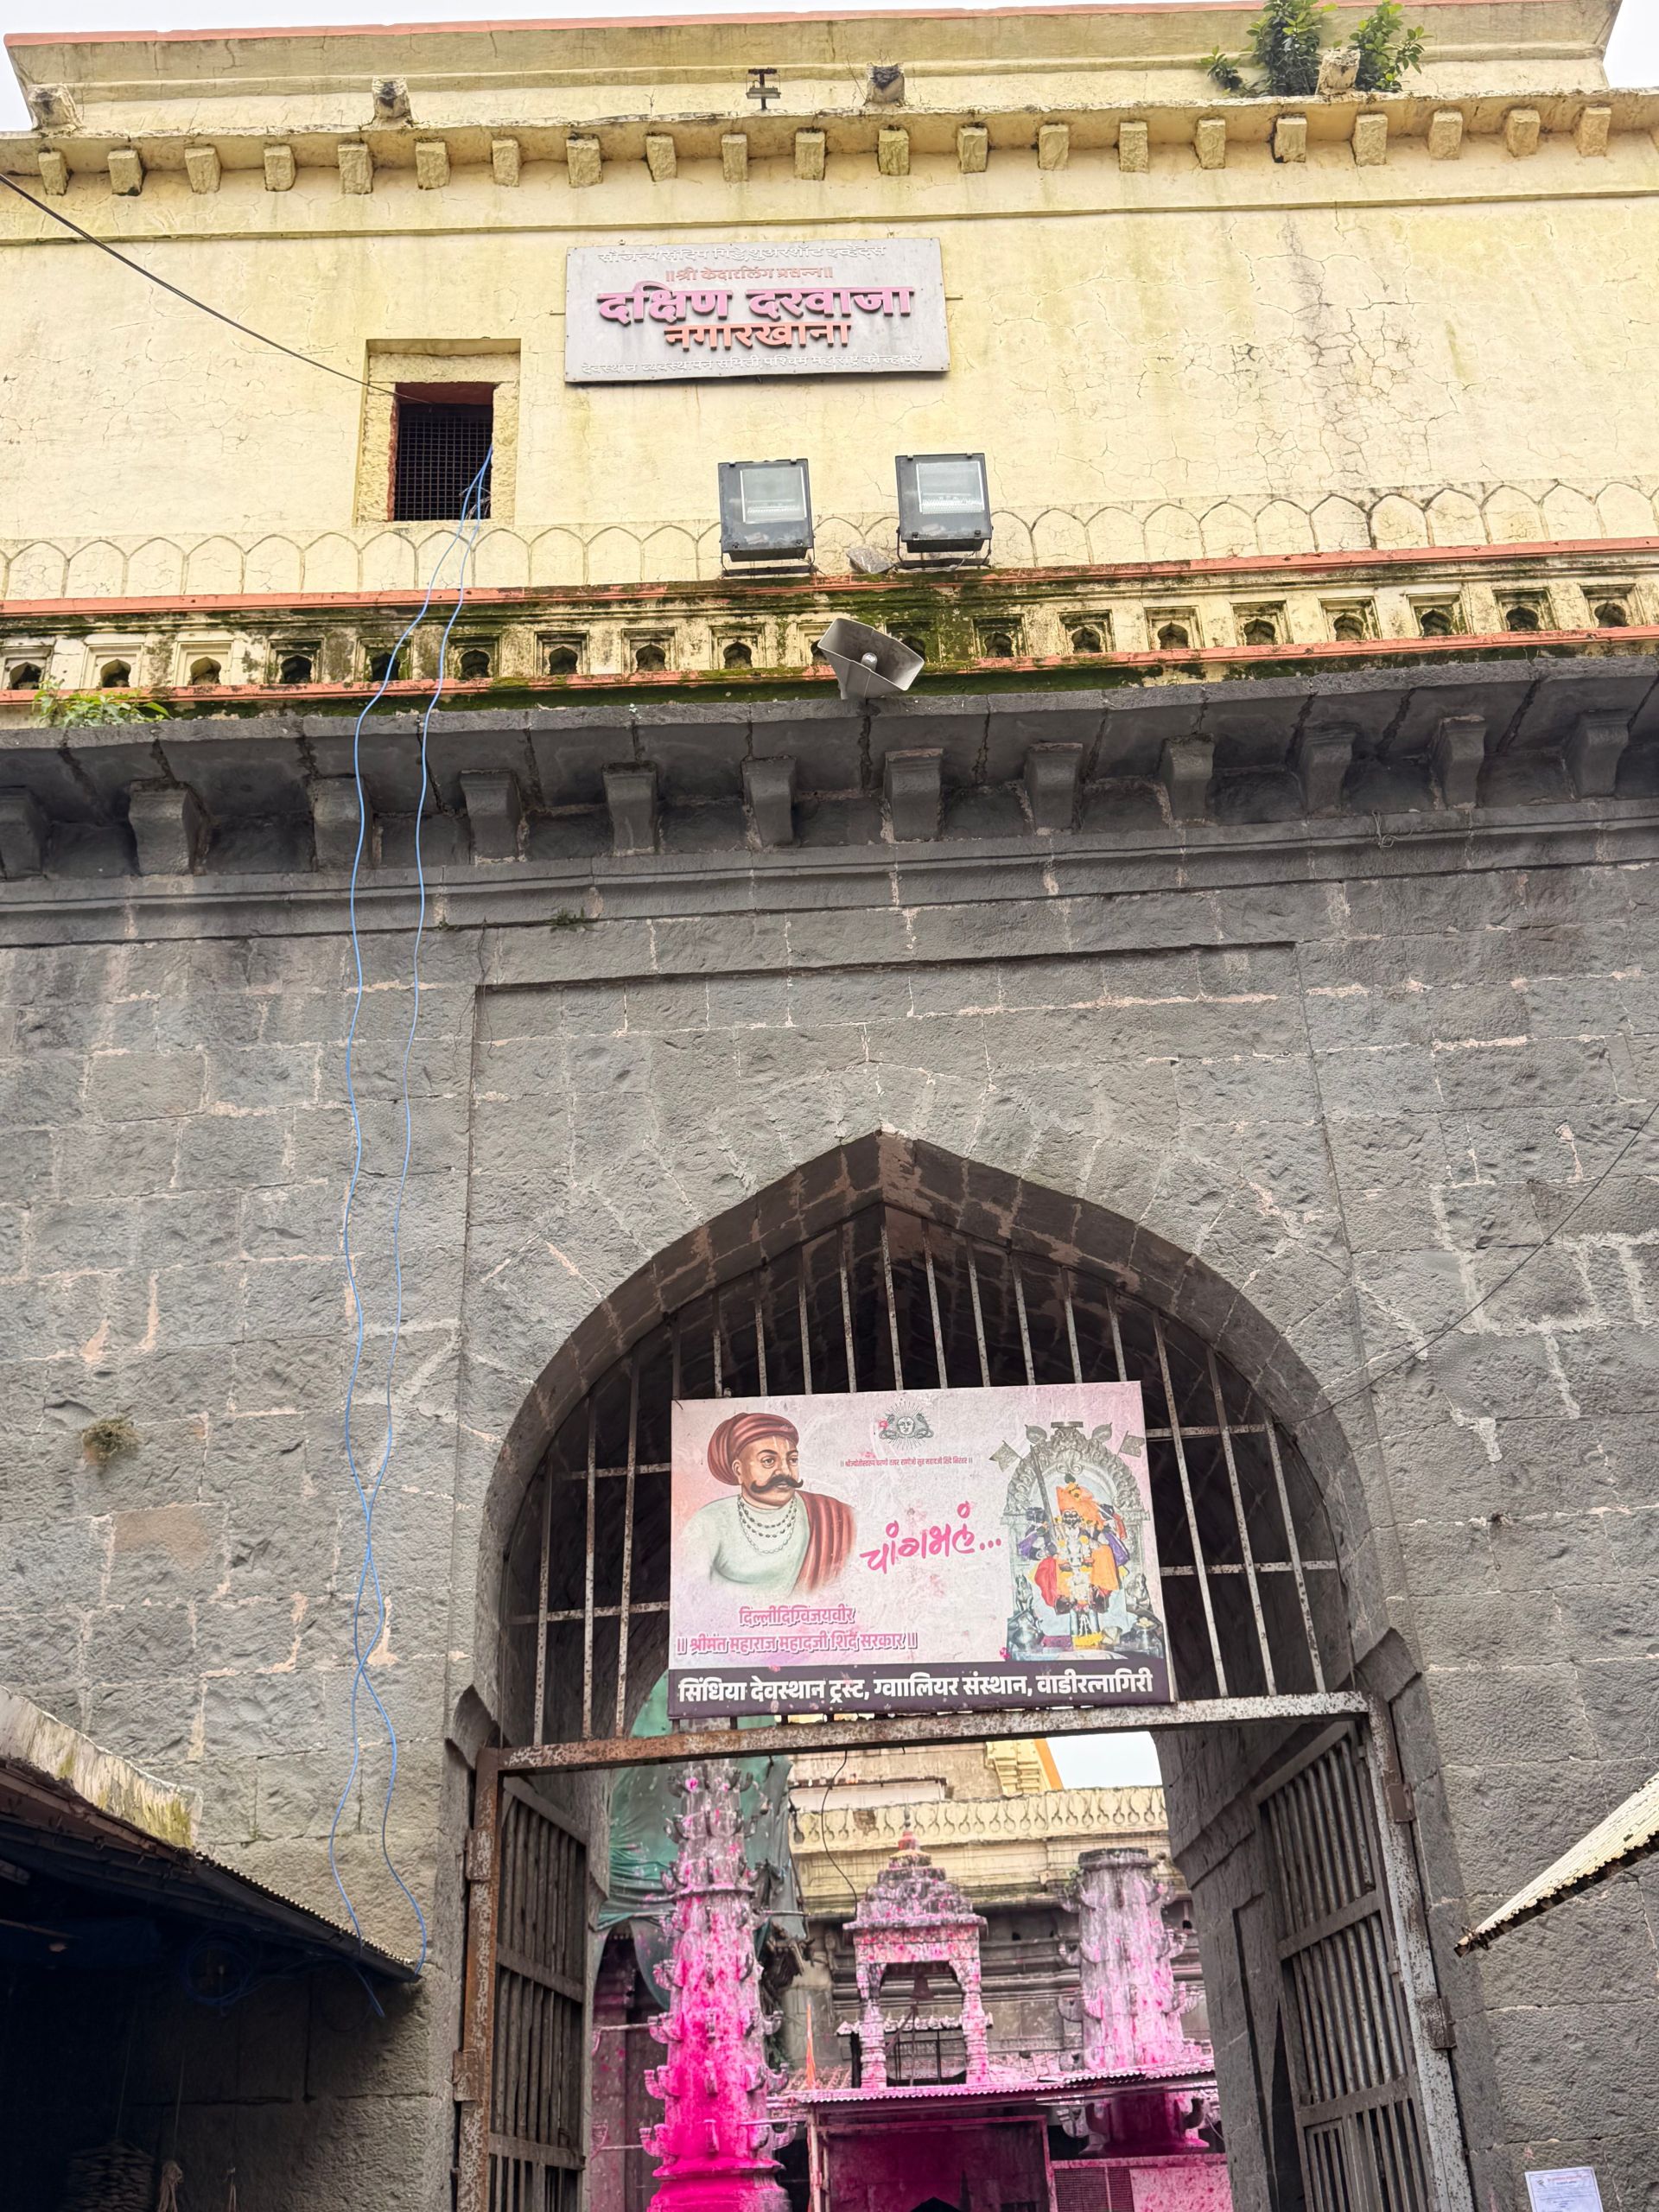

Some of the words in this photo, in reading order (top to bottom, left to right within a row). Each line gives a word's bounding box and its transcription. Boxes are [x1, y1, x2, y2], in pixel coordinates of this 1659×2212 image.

[701, 265, 773, 281] केदारलिंग
[596, 280, 733, 327] दक्षिण
[746, 286, 915, 321] दरवाजा
[664, 321, 852, 352] नगारखाना
[581, 362, 639, 375] देवस्थान
[690, 1632, 729, 1656] श्रीमंत
[729, 1636, 779, 1656] महाराज
[779, 1630, 830, 1654] महादजी
[860, 1632, 906, 1650] सरकार
[678, 1677, 747, 1702] सिंधिया
[750, 1675, 827, 1702] देवस्थान
[829, 1679, 870, 1704] ट्रस्ट,
[961, 1670, 1033, 1697] संस्थान,
[1035, 1667, 1154, 1694] वाडीरत्नागिरी
